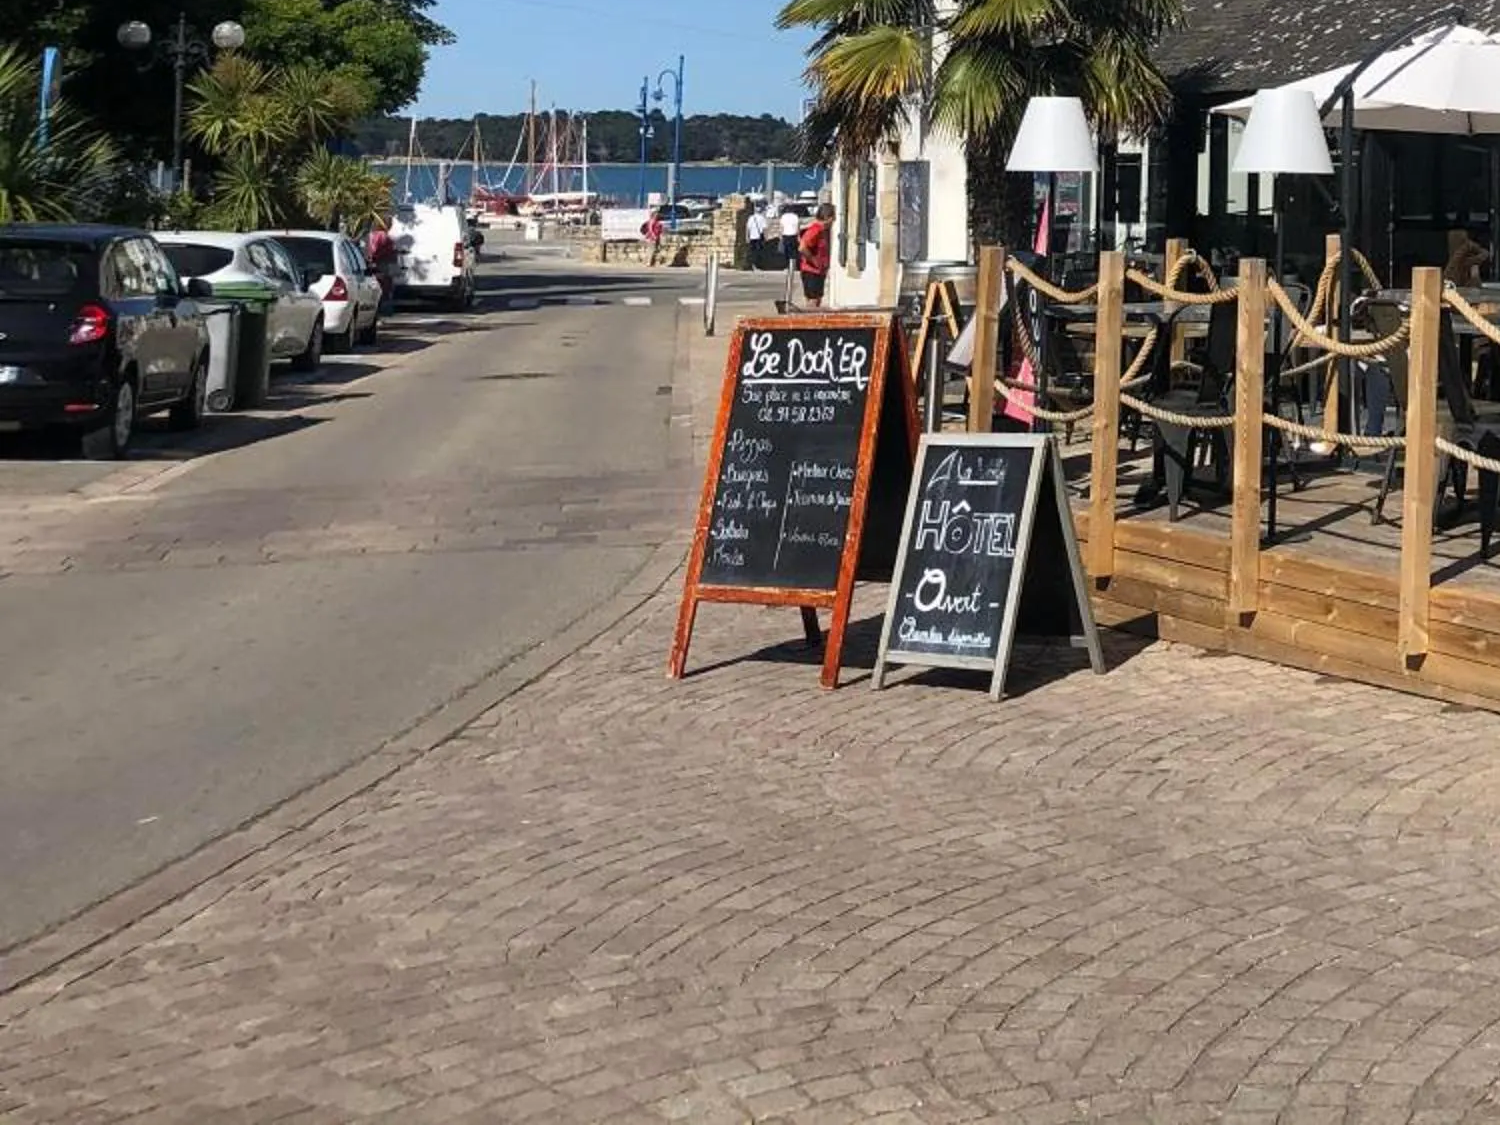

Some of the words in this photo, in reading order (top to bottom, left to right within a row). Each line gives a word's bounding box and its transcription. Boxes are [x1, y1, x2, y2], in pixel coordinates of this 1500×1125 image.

[743, 333, 781, 377] Le
[915, 499, 1017, 557] HÔTEL
[914, 568, 983, 613] Ouvert
